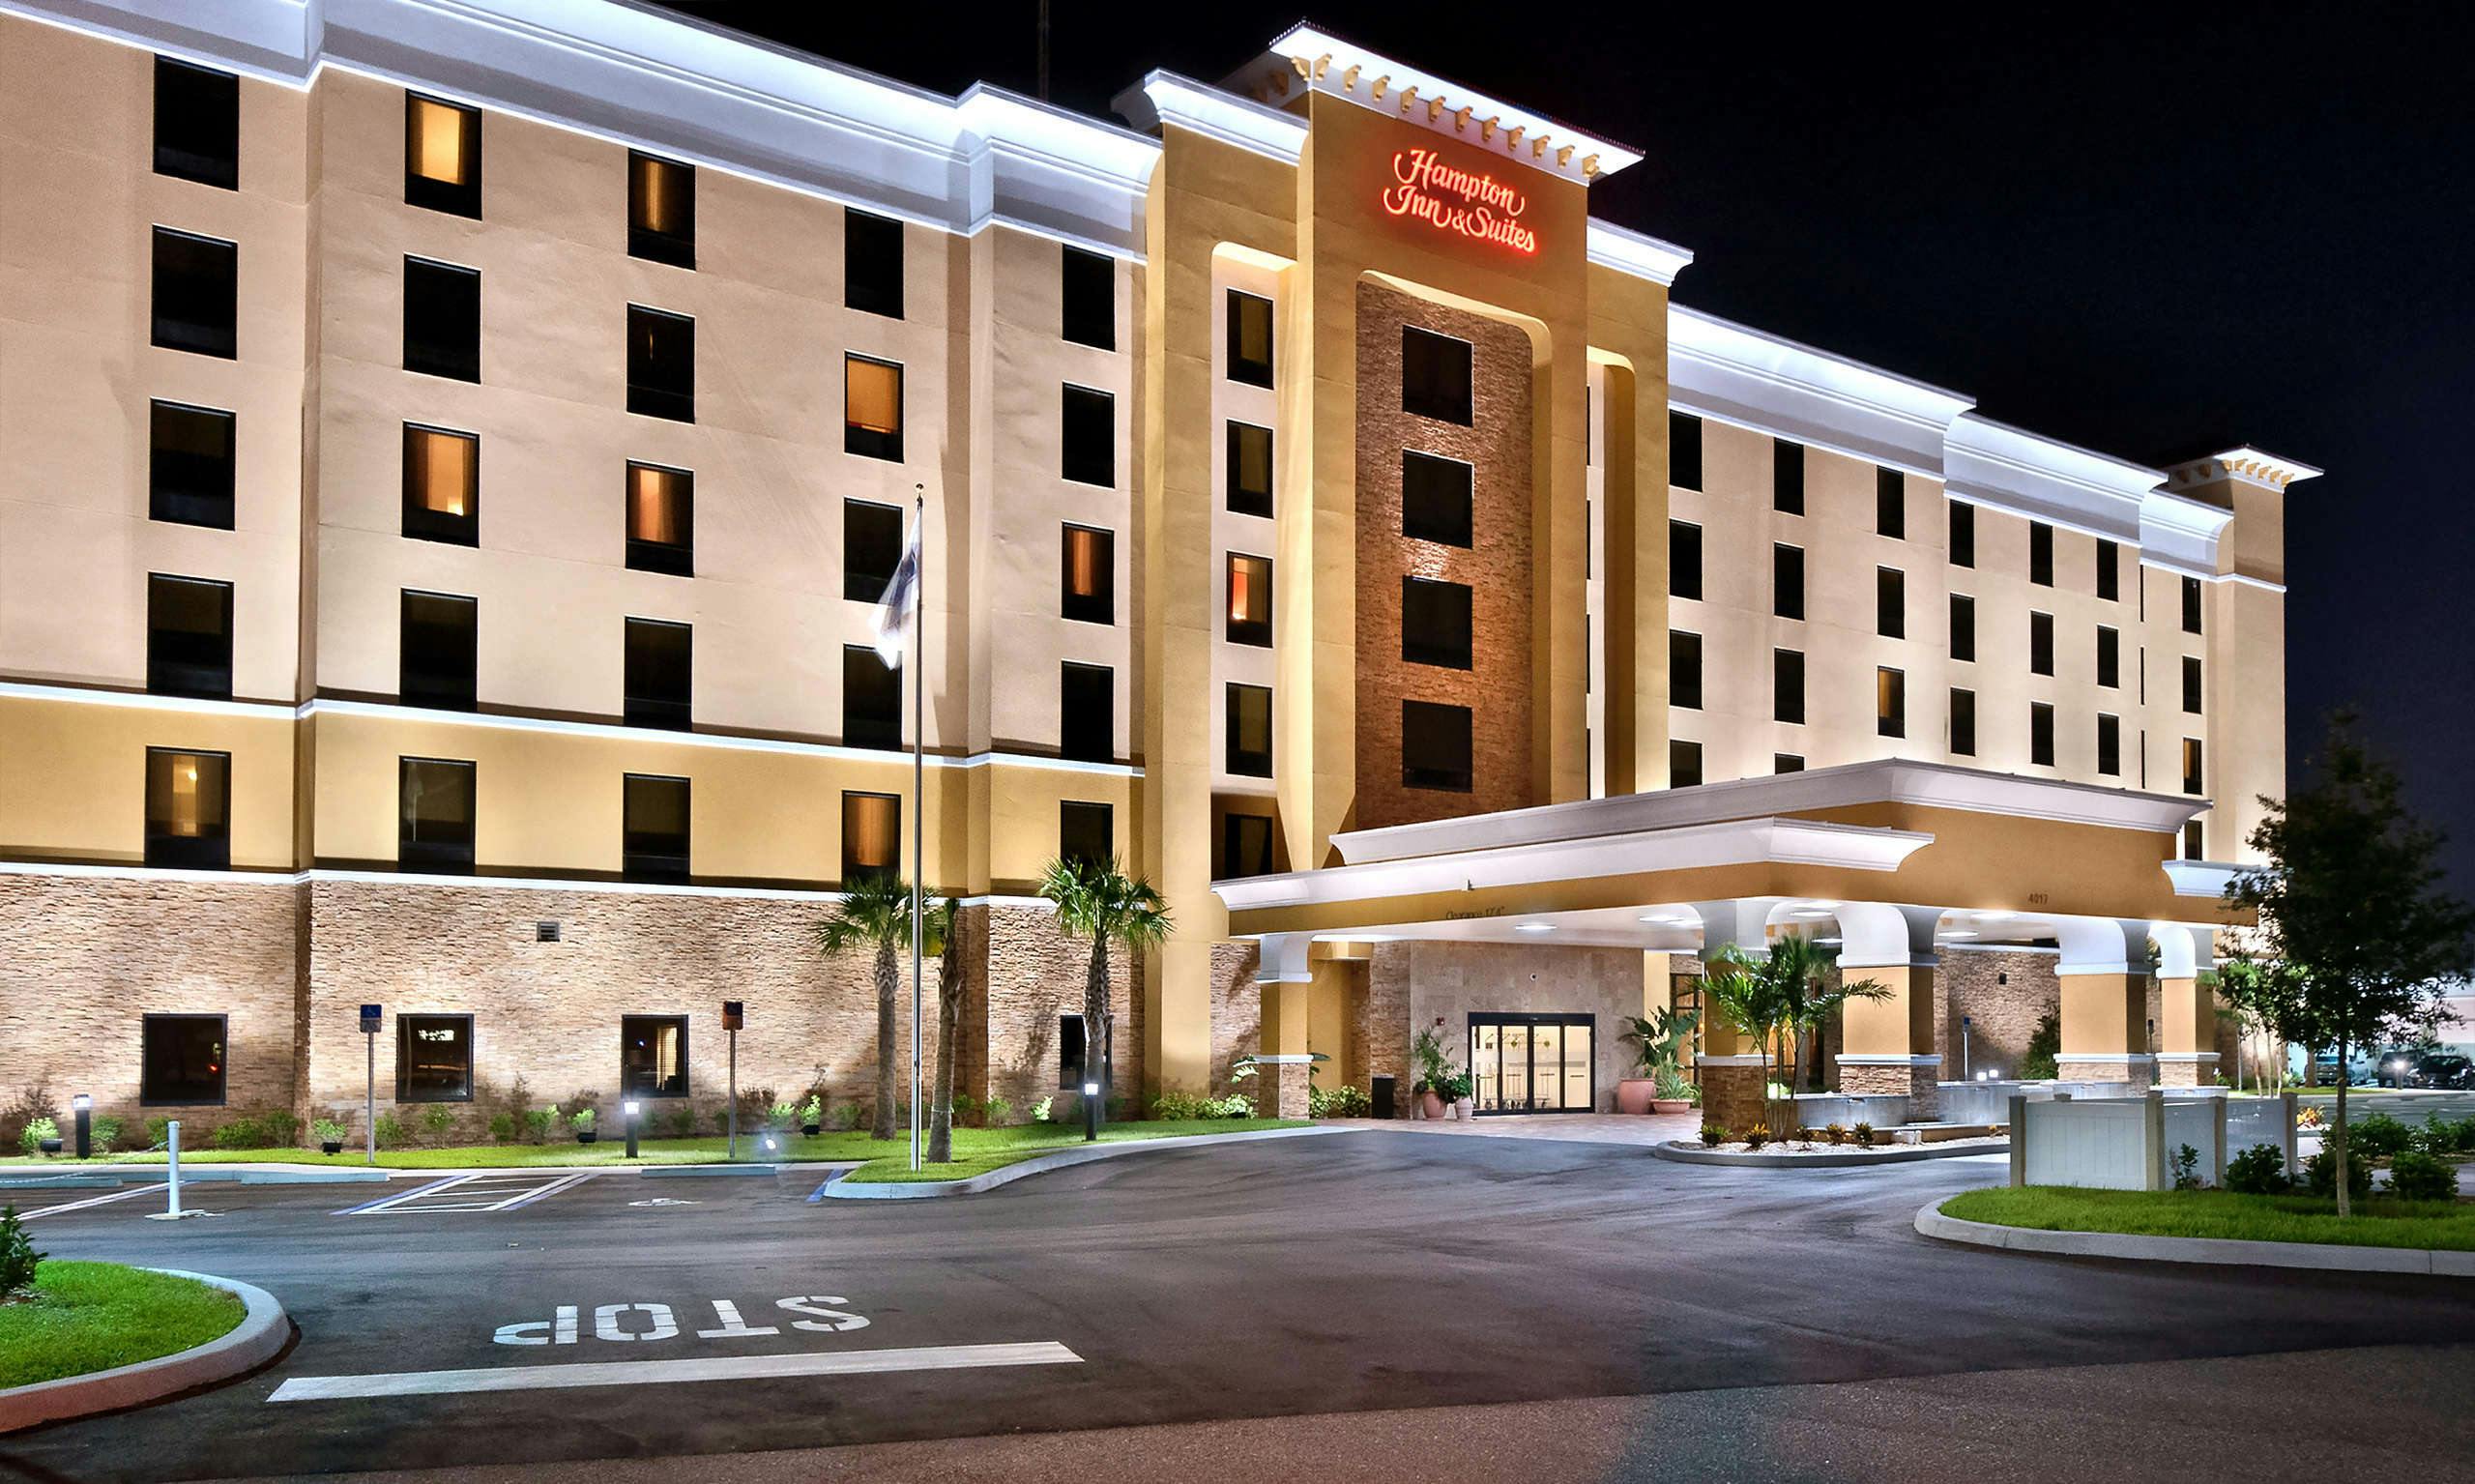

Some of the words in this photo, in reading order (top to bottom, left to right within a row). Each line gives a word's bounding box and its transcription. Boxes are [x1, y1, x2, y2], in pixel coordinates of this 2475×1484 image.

[1394, 150, 1525, 217] Hampton
[1383, 186, 1452, 228] Inn
[1452, 209, 1470, 236] &
[1467, 207, 1535, 252] Suites
[492, 1295, 871, 1345] STOP
